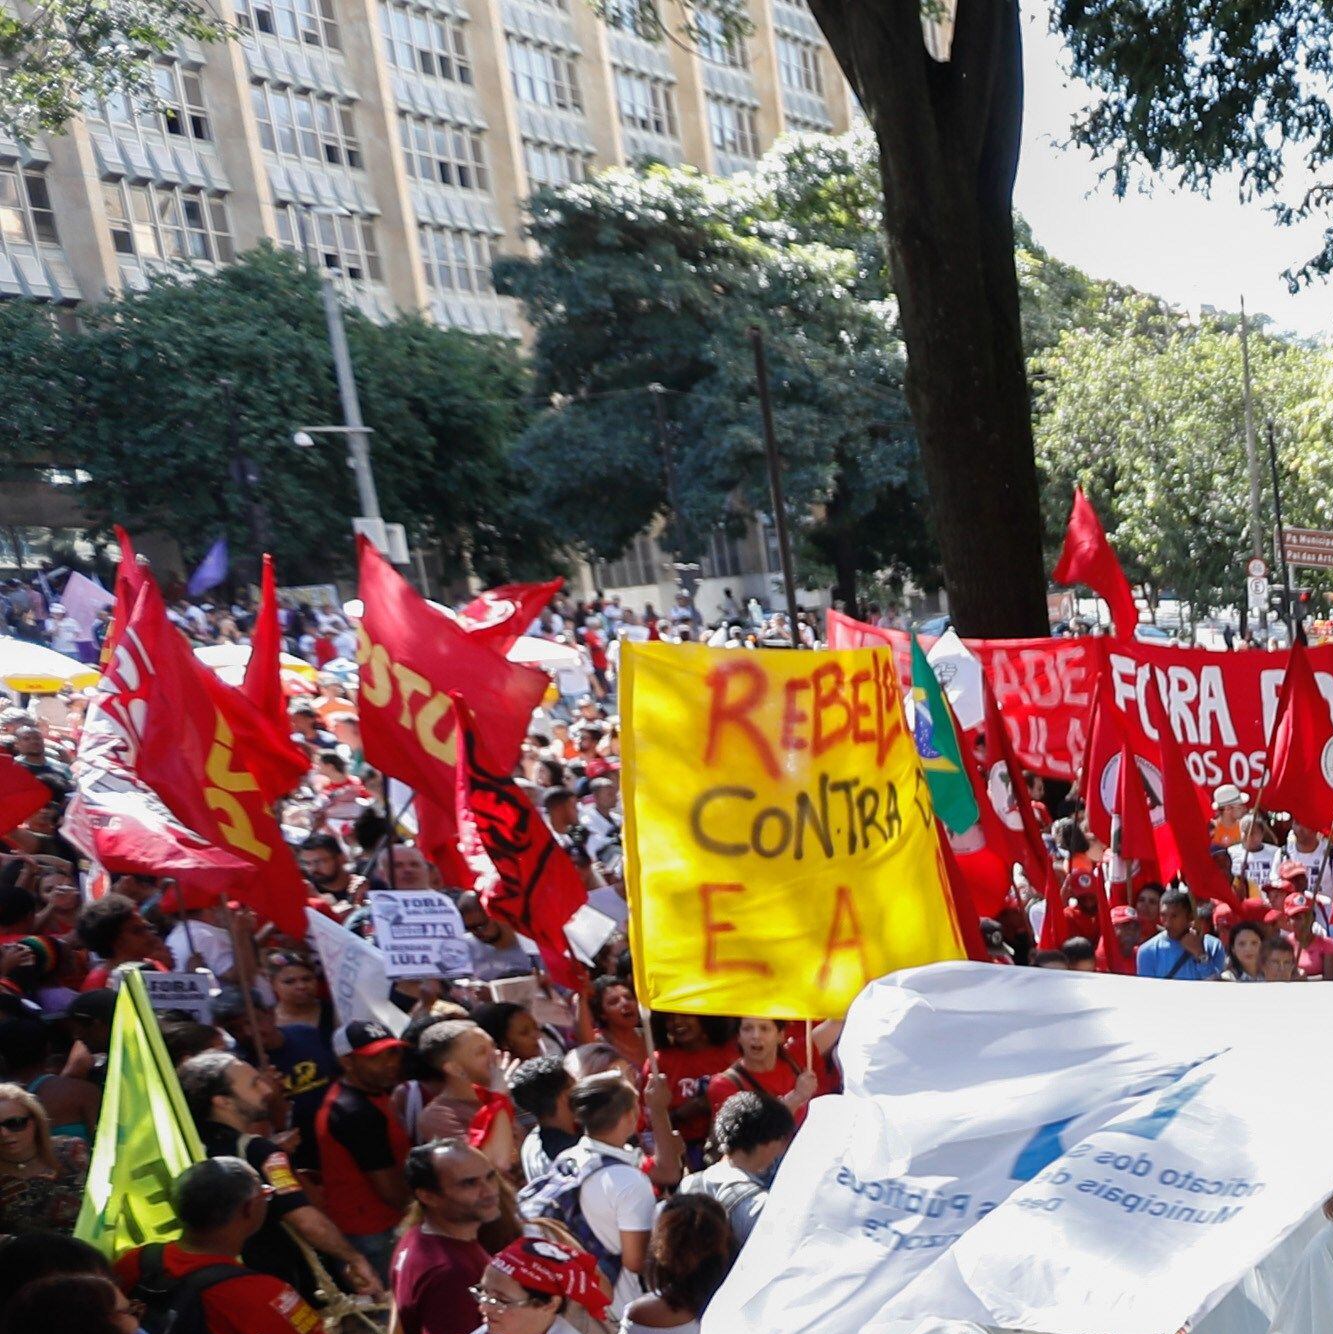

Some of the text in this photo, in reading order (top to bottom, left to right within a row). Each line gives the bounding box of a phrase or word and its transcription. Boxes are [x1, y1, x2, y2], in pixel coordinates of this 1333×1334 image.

[1109, 652, 1238, 747] FORA
[402, 897, 447, 908] FORA
[391, 953, 431, 965] LULA
